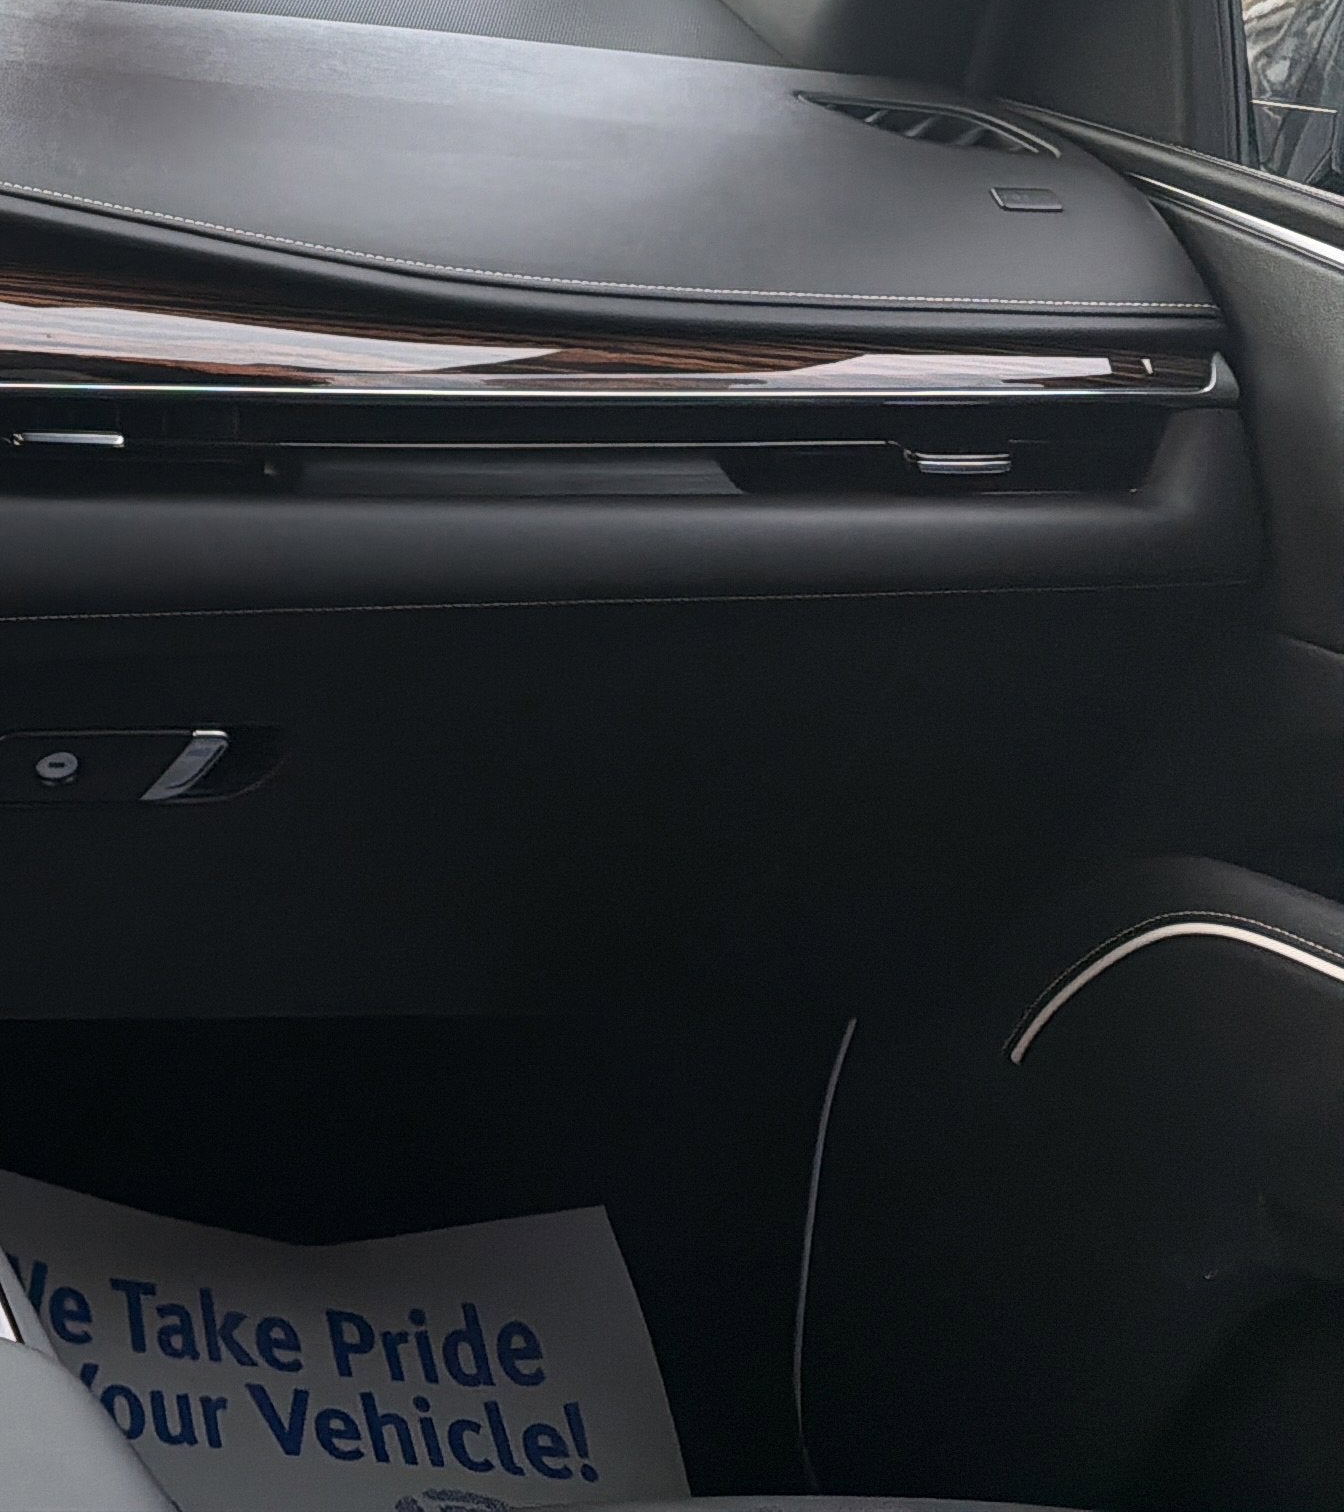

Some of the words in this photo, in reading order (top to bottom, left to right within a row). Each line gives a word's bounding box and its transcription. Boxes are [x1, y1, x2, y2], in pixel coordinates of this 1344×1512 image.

[109, 1276, 302, 1372] Take
[325, 1301, 548, 1388] Pride
[244, 1381, 599, 1484] Vehicle!
